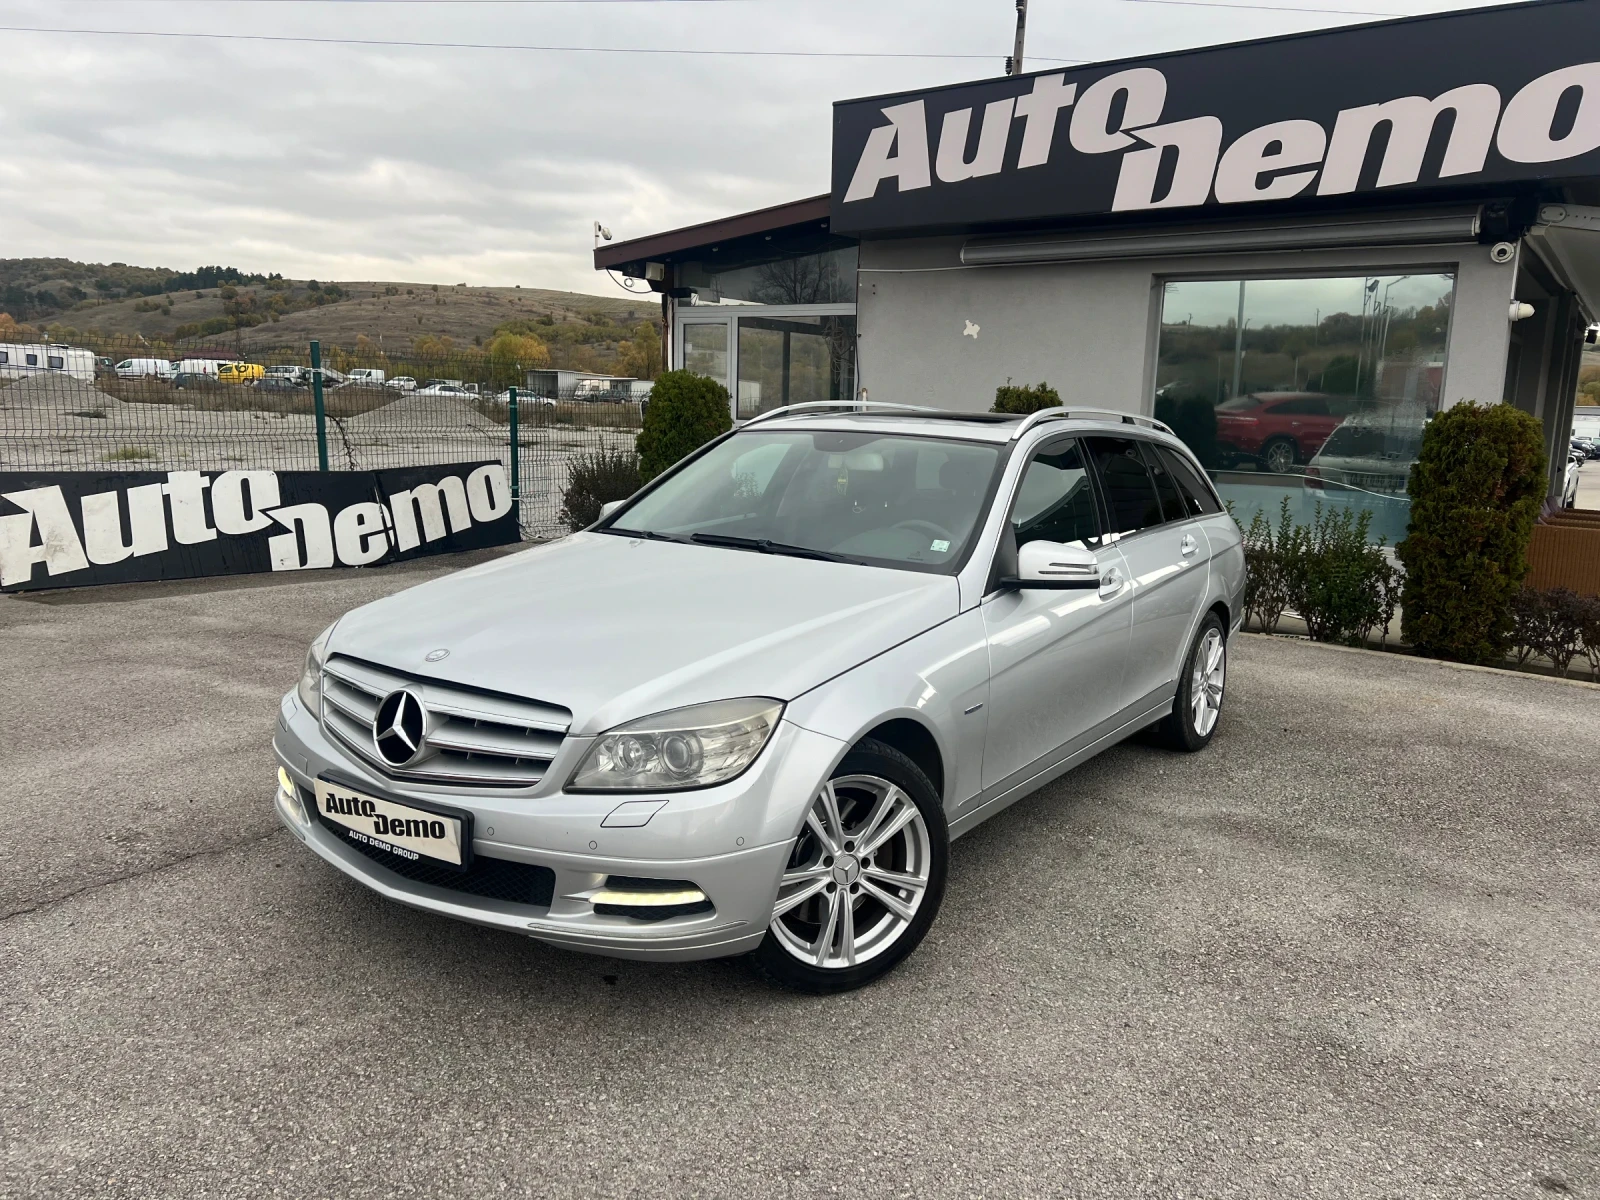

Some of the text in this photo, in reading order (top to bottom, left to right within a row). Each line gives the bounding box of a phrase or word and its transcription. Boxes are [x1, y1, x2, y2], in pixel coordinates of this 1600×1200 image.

[844, 62, 1600, 212] Auto Demo
[0, 464, 513, 586] Auto Demo
[326, 793, 446, 839] Auto Demo
[348, 830, 419, 861] AUTO DEMO GROUP
